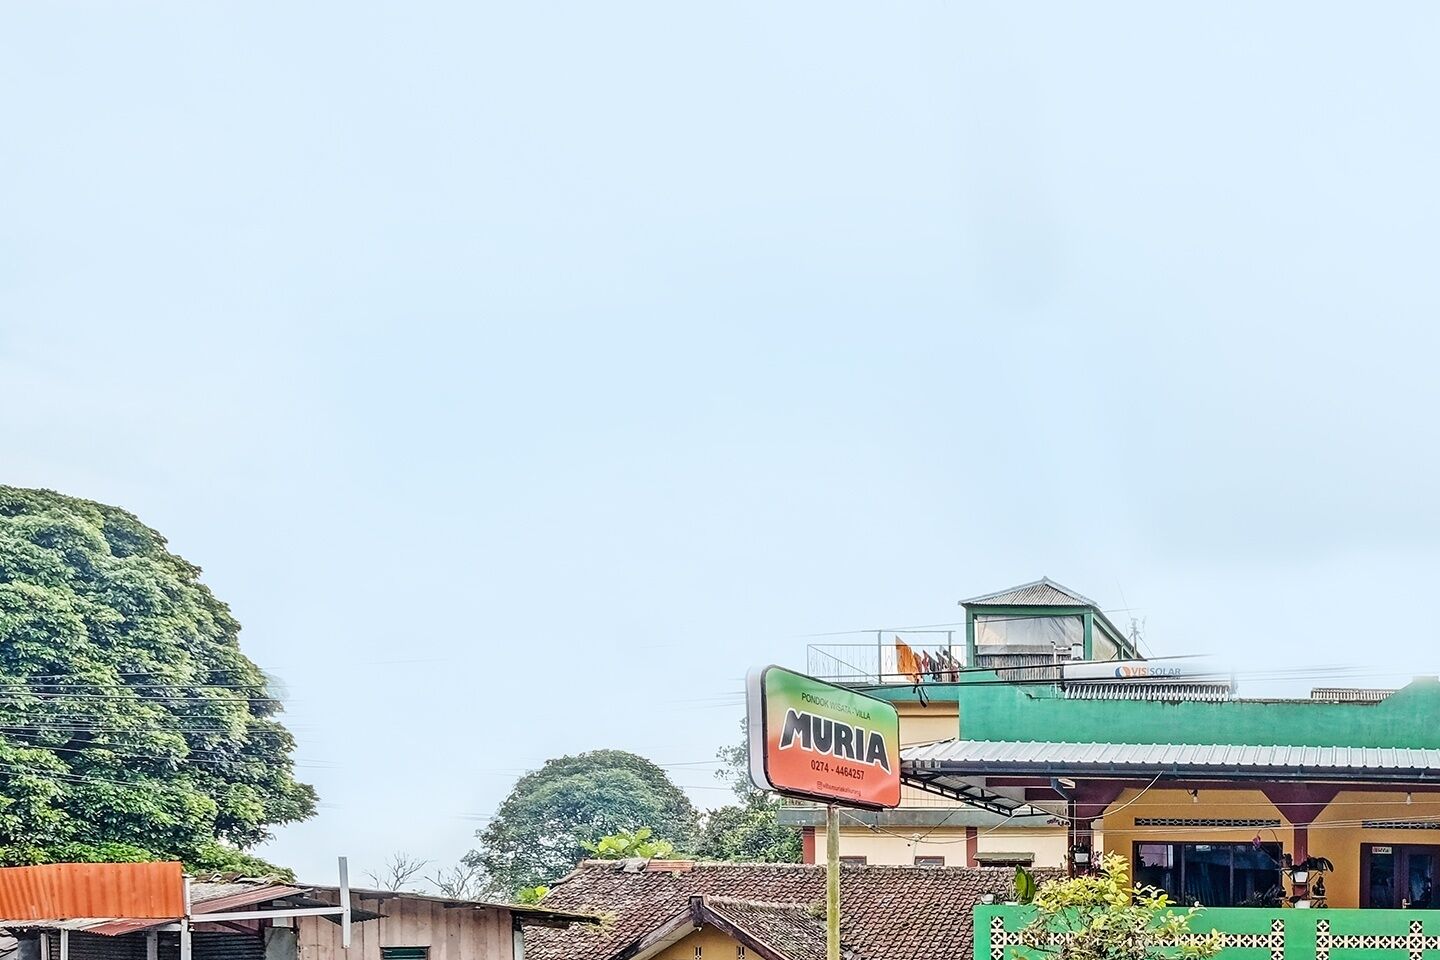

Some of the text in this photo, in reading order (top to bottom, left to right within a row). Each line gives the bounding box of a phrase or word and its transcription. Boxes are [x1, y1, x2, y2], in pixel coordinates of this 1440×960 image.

[801, 692, 829, 708] PONDOK
[829, 701, 852, 715] WISATA
[854, 708, 872, 720] VILLA
[779, 708, 891, 775] MURIA
[810, 760, 829, 773] 0274
[835, 764, 865, 780] 4464257
